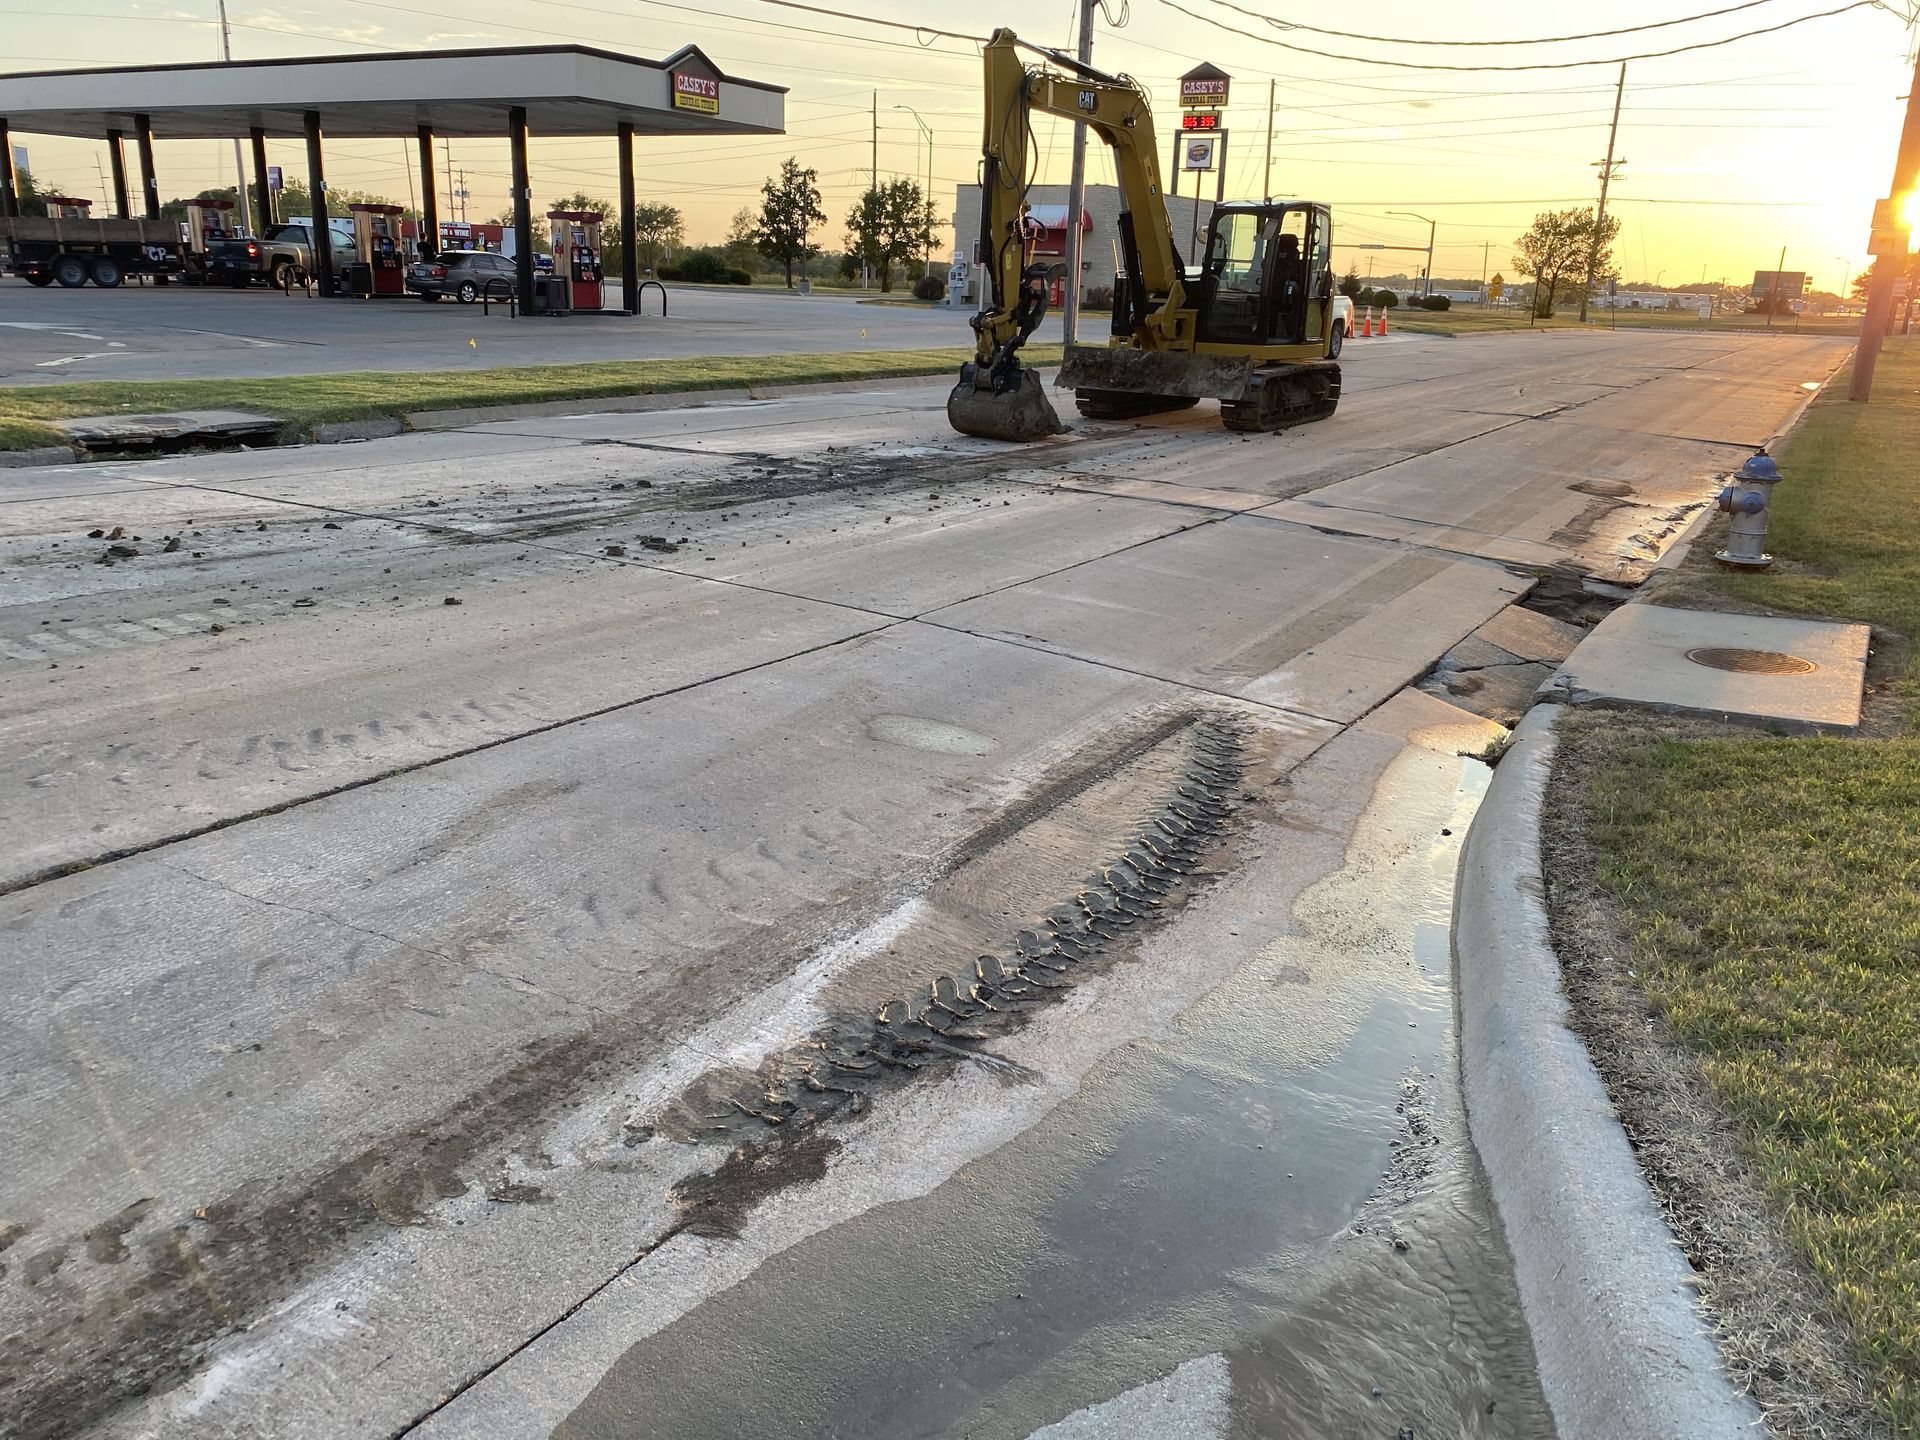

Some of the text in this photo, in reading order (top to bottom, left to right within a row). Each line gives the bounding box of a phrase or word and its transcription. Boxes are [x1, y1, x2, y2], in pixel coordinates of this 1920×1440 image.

[677, 75, 716, 96] CASEY'S
[1183, 81, 1224, 94] CASEY'S
[1078, 90, 1095, 110] CAT
[1183, 95, 1223, 104] GENERAL STORE
[453, 229, 470, 237] WINE
